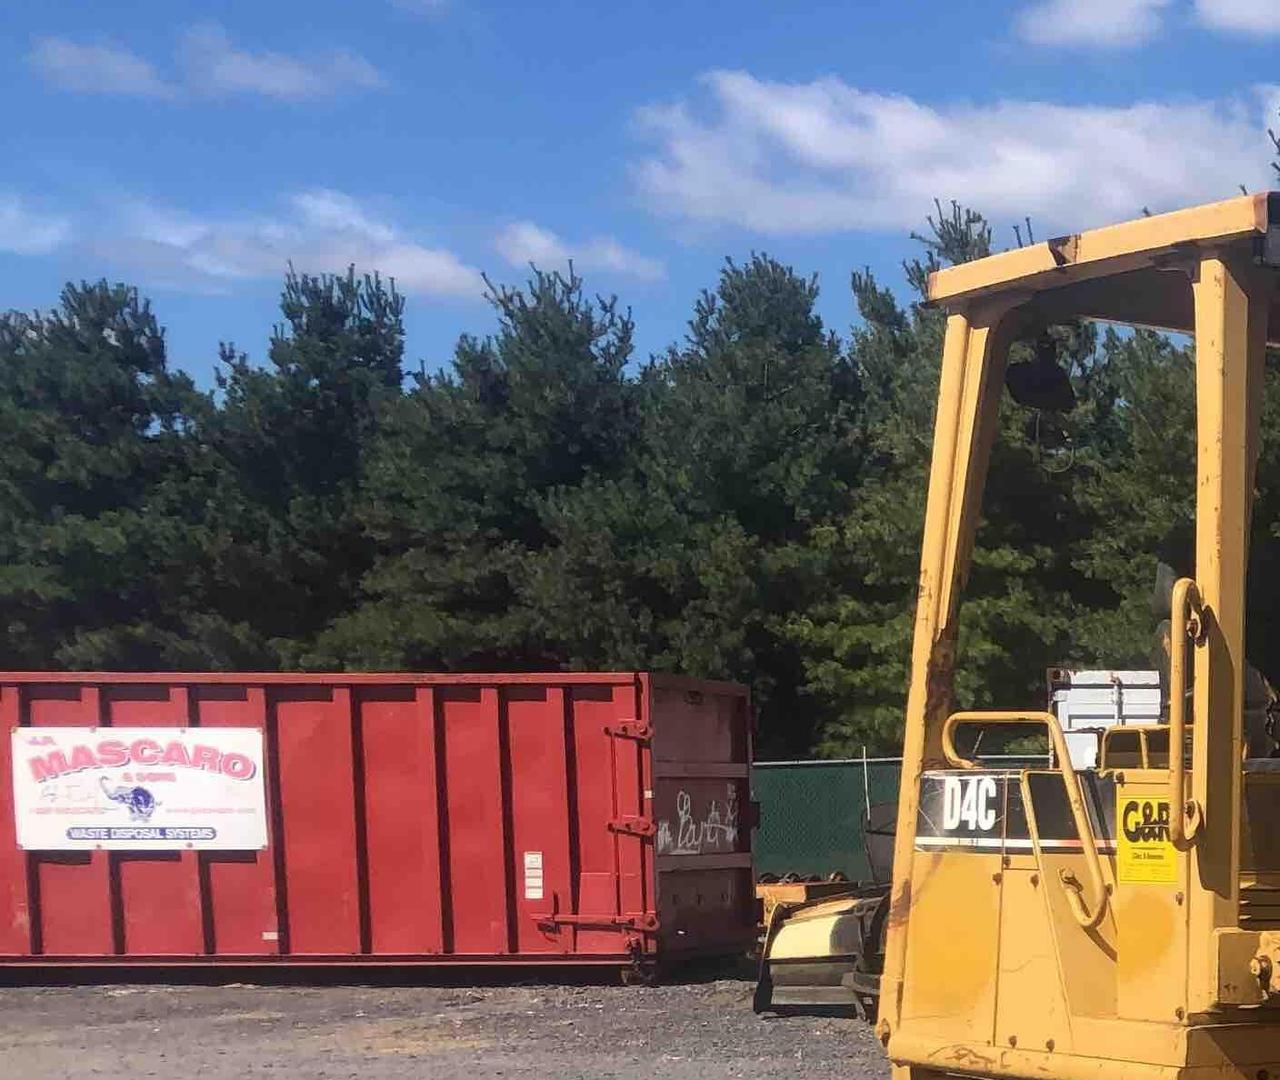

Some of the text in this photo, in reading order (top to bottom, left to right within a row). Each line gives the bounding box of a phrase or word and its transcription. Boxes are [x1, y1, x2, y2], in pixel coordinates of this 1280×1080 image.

[28, 738, 256, 783] MASCARO
[943, 776, 997, 830] D4C
[70, 829, 214, 840] WASTE DISPOSAL SYSTEMS
